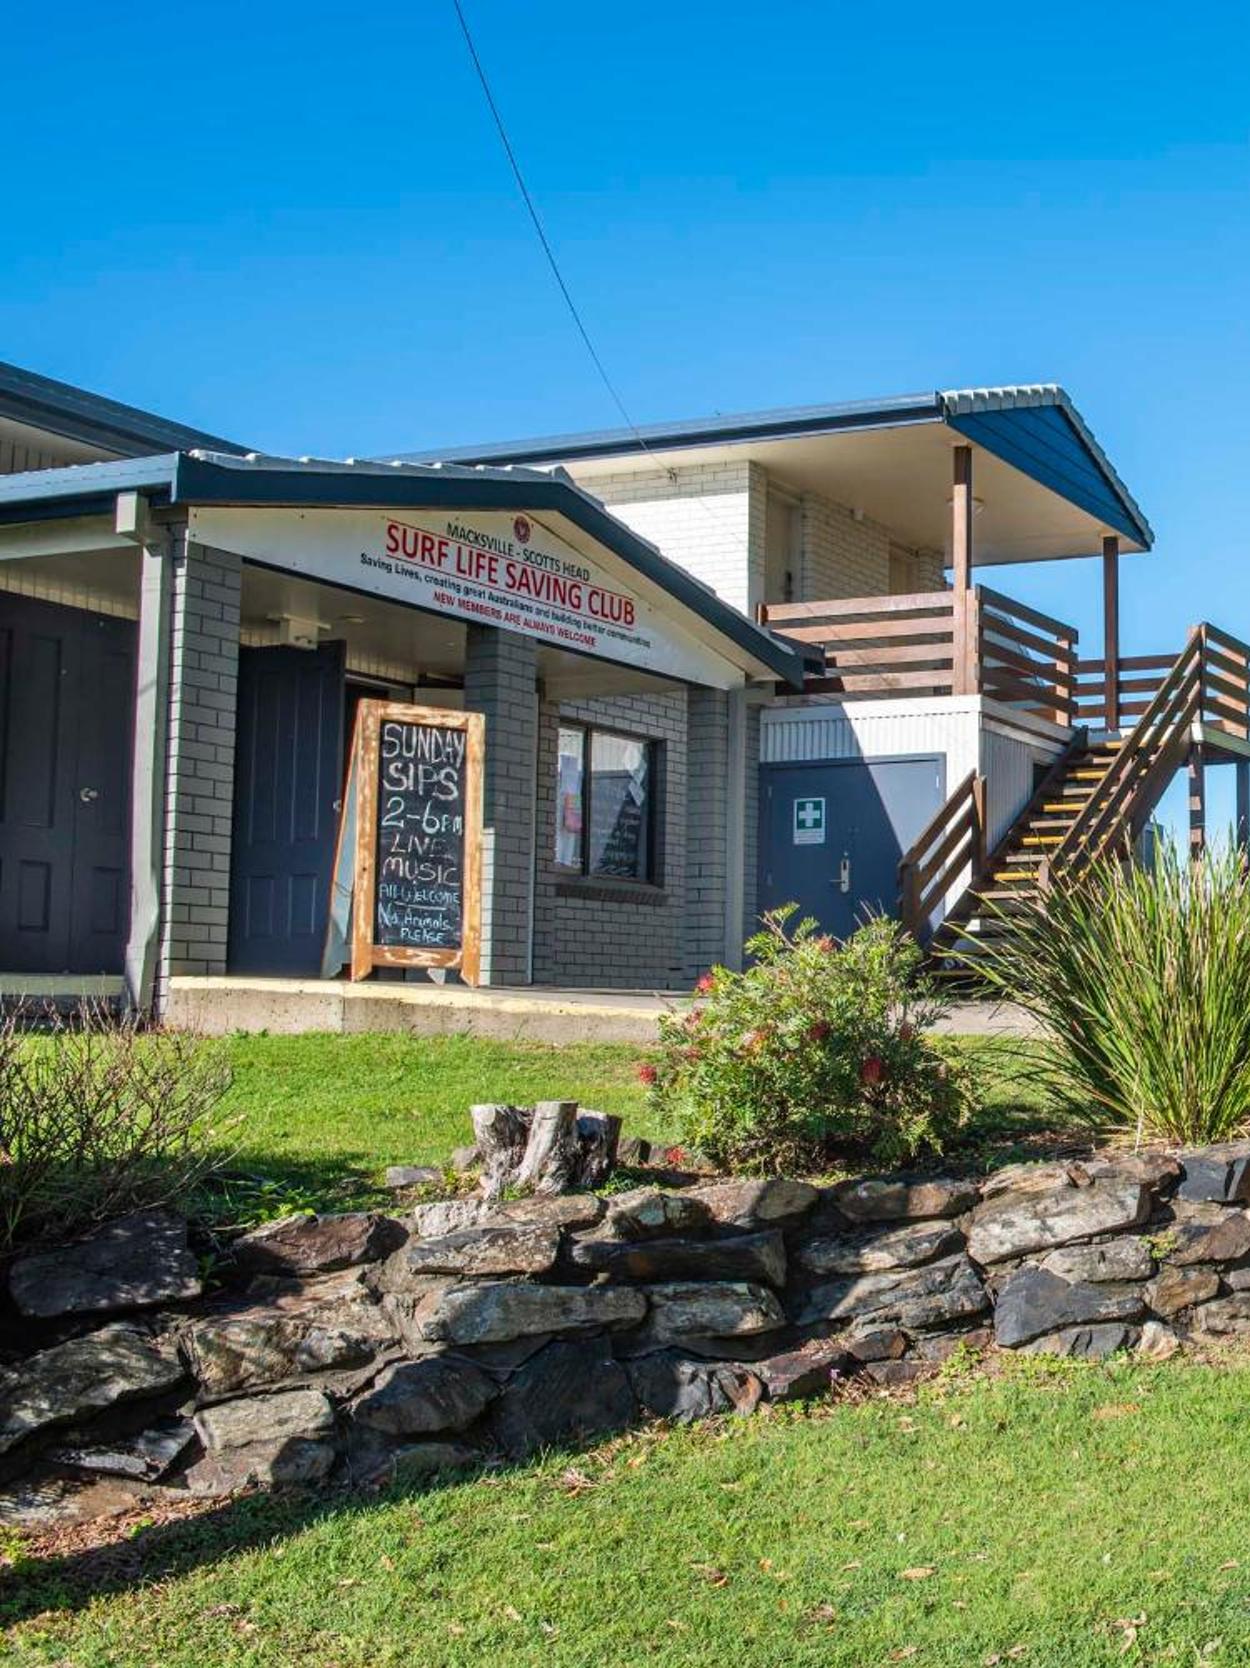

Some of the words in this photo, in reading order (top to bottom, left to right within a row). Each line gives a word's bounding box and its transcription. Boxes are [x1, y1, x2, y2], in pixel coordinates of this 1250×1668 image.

[386, 524, 449, 567] SURF
[456, 546, 499, 584] LIFE
[505, 563, 582, 610] SAVING
[588, 589, 635, 625] CLUB
[447, 522, 514, 557] MACKSVILLE
[523, 549, 561, 572] SCOTTS
[562, 562, 590, 582] HEAD
[361, 552, 392, 573] Saving
[395, 562, 422, 583] Lives,
[424, 574, 461, 594] creating
[463, 583, 486, 599] great
[488, 591, 534, 613] Australians
[535, 604, 550, 619] and
[434, 591, 456, 607] NEW
[457, 597, 502, 620] MEMBERS
[503, 611, 521, 626] ARE
[523, 618, 556, 635] ALWAYS
[557, 627, 597, 646] WELCOME
[382, 723, 465, 769] SUNDAY
[383, 762, 458, 800] SIPS
[382, 856, 461, 887] MUSIC
